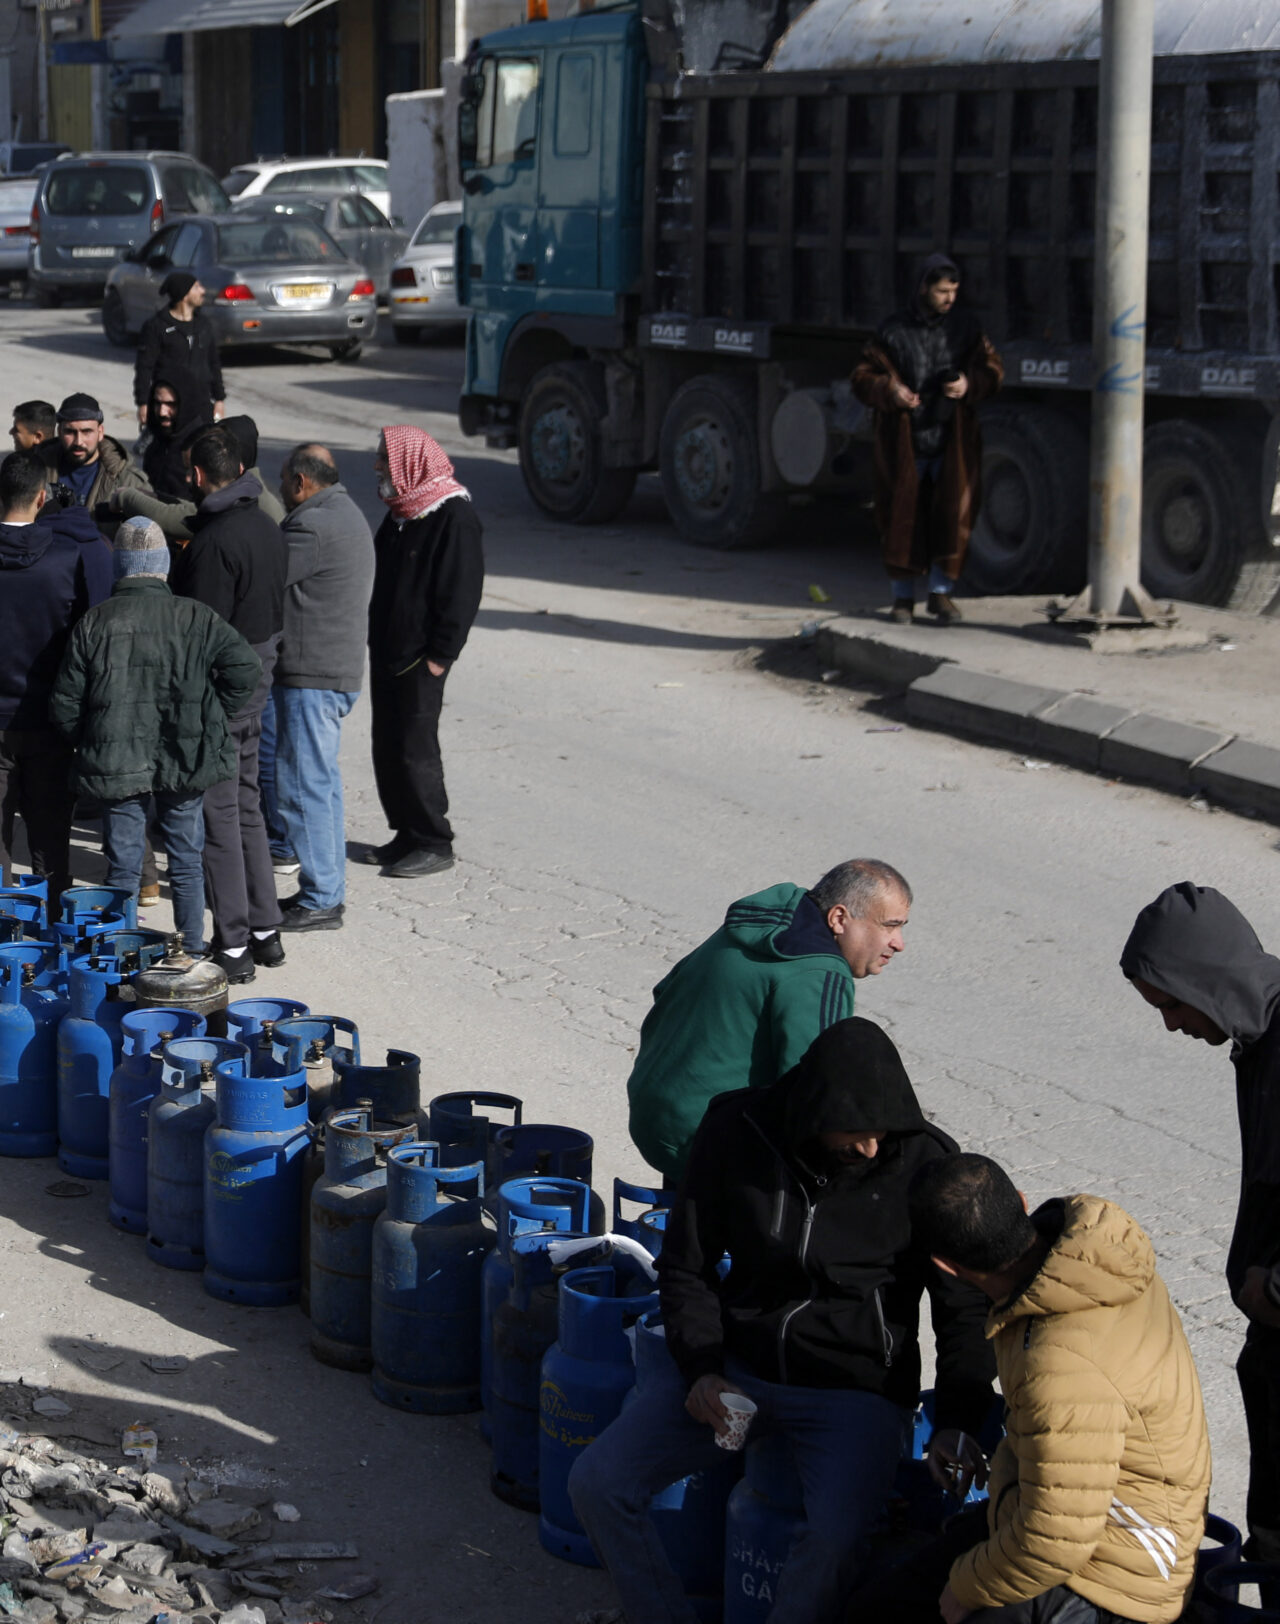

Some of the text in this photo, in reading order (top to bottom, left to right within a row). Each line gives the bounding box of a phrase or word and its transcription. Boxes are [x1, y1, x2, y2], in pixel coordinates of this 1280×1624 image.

[650, 323, 688, 339] DAF
[714, 329, 754, 345] DAF
[1020, 358, 1070, 377] DAF
[1200, 367, 1257, 385] DAF
[741, 1572, 773, 1604] GA
